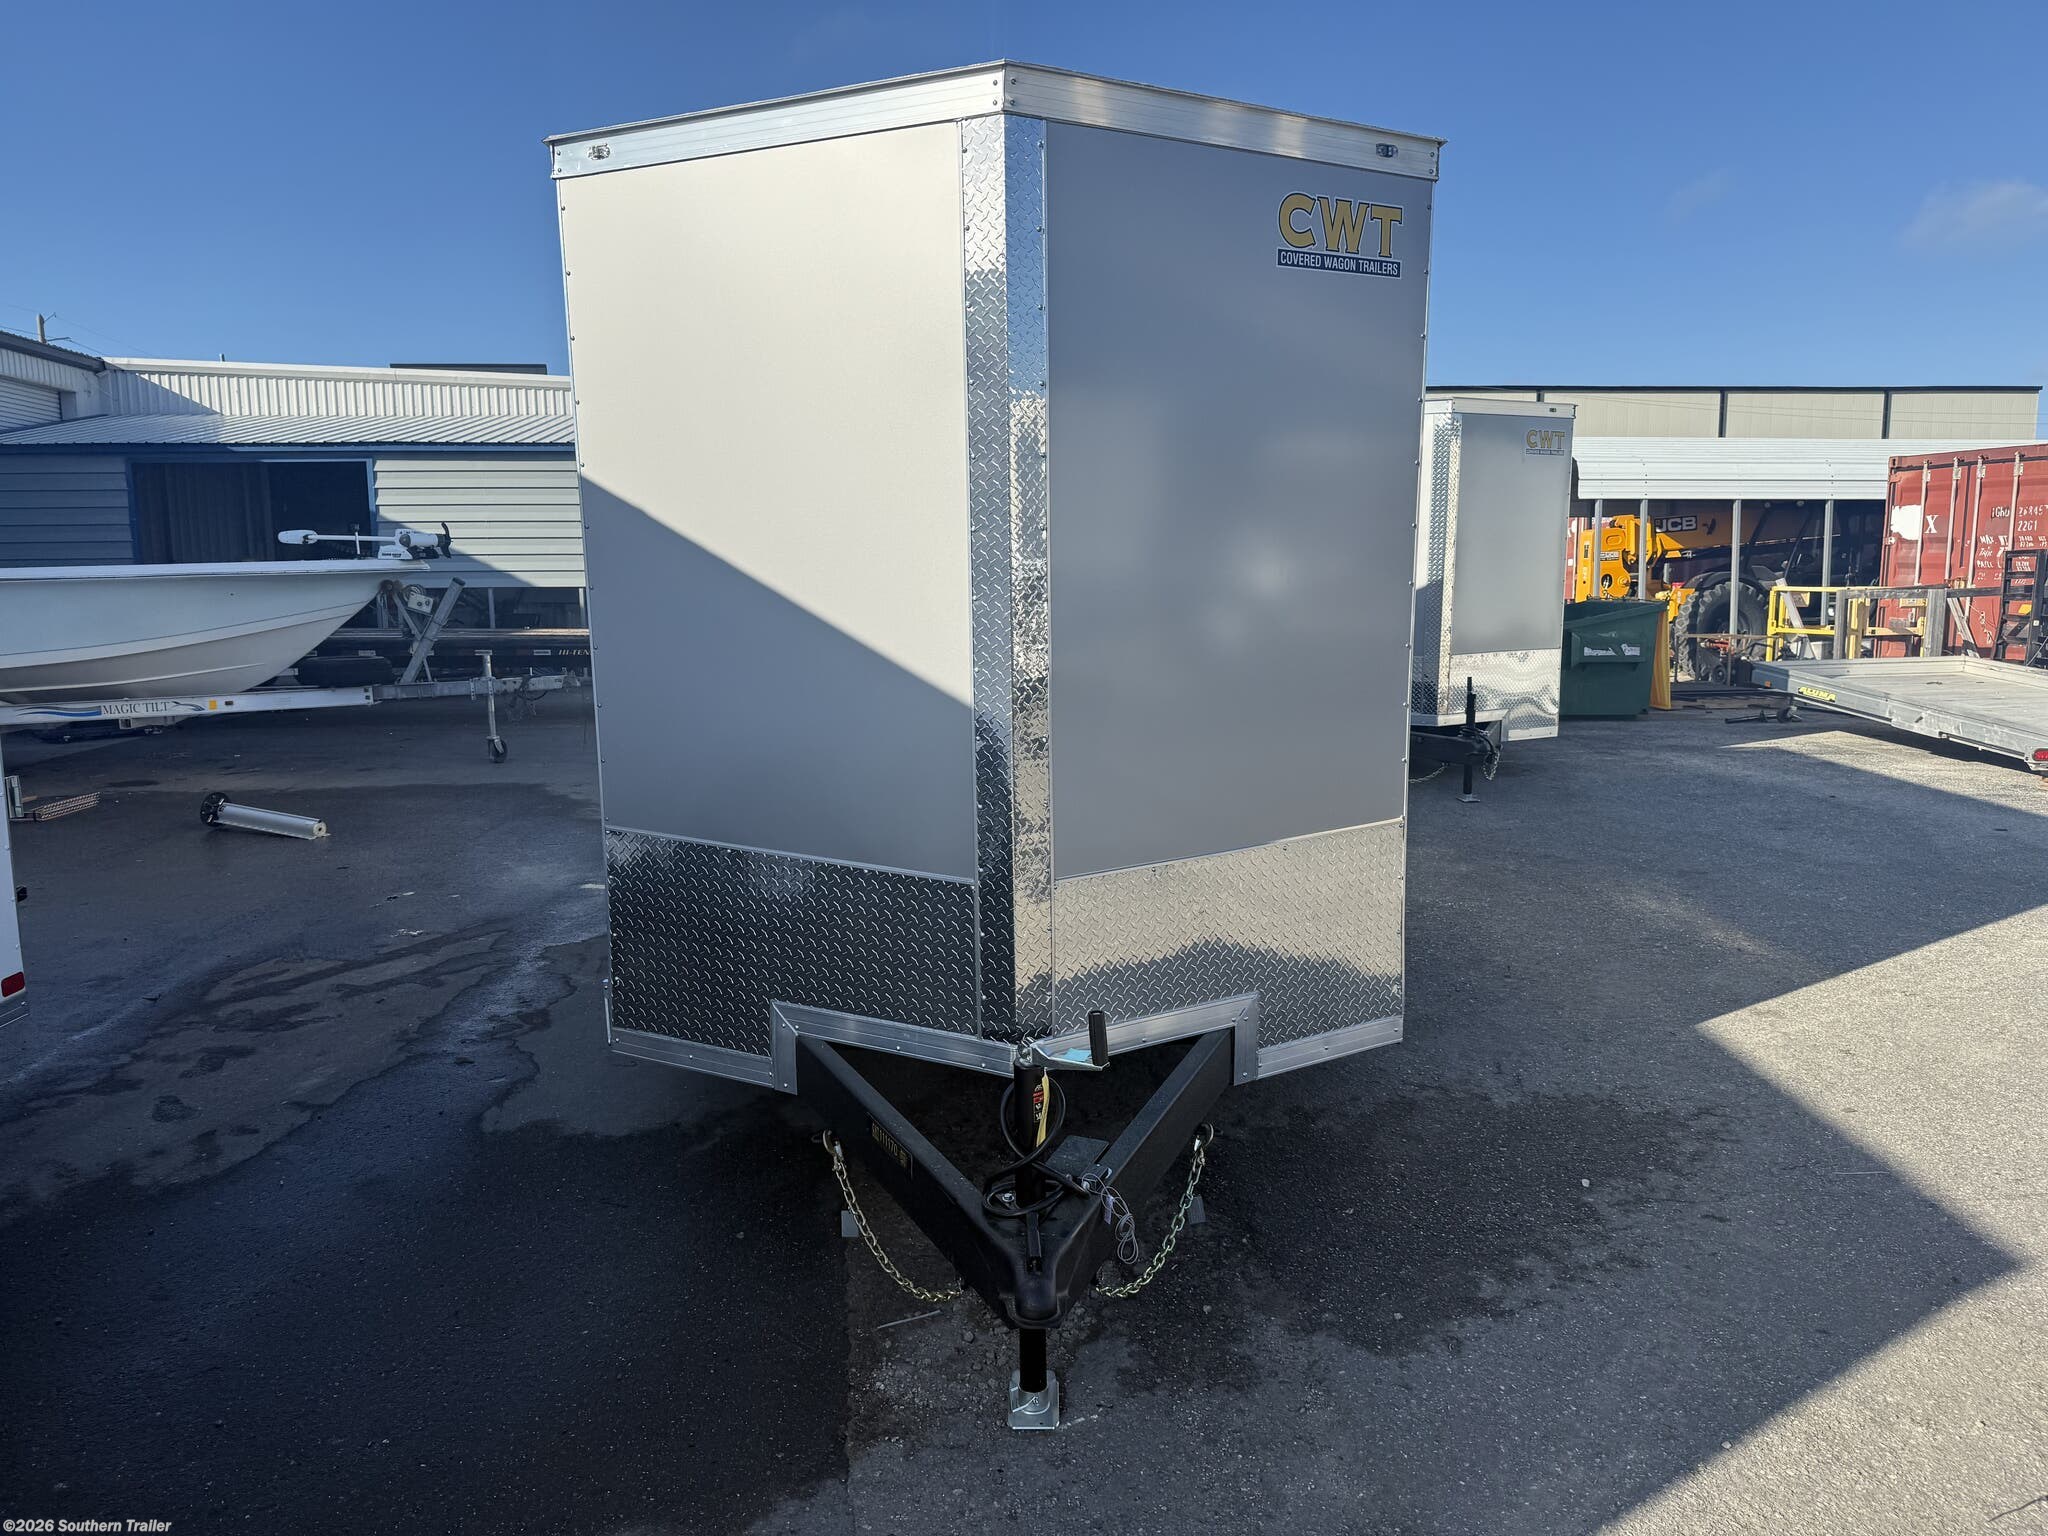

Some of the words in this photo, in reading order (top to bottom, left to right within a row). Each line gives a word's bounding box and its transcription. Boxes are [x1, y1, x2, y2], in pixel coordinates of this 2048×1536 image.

[1278, 192, 1403, 258] CWT
[1280, 251, 1321, 267] COVERED
[1324, 256, 1356, 271] WAGON
[1358, 260, 1399, 275] TRAILERS
[1526, 429, 1566, 449] CWT
[1656, 516, 1697, 532] JCB
[103, 703, 141, 715] MAGIC
[142, 701, 170, 713] TILT
